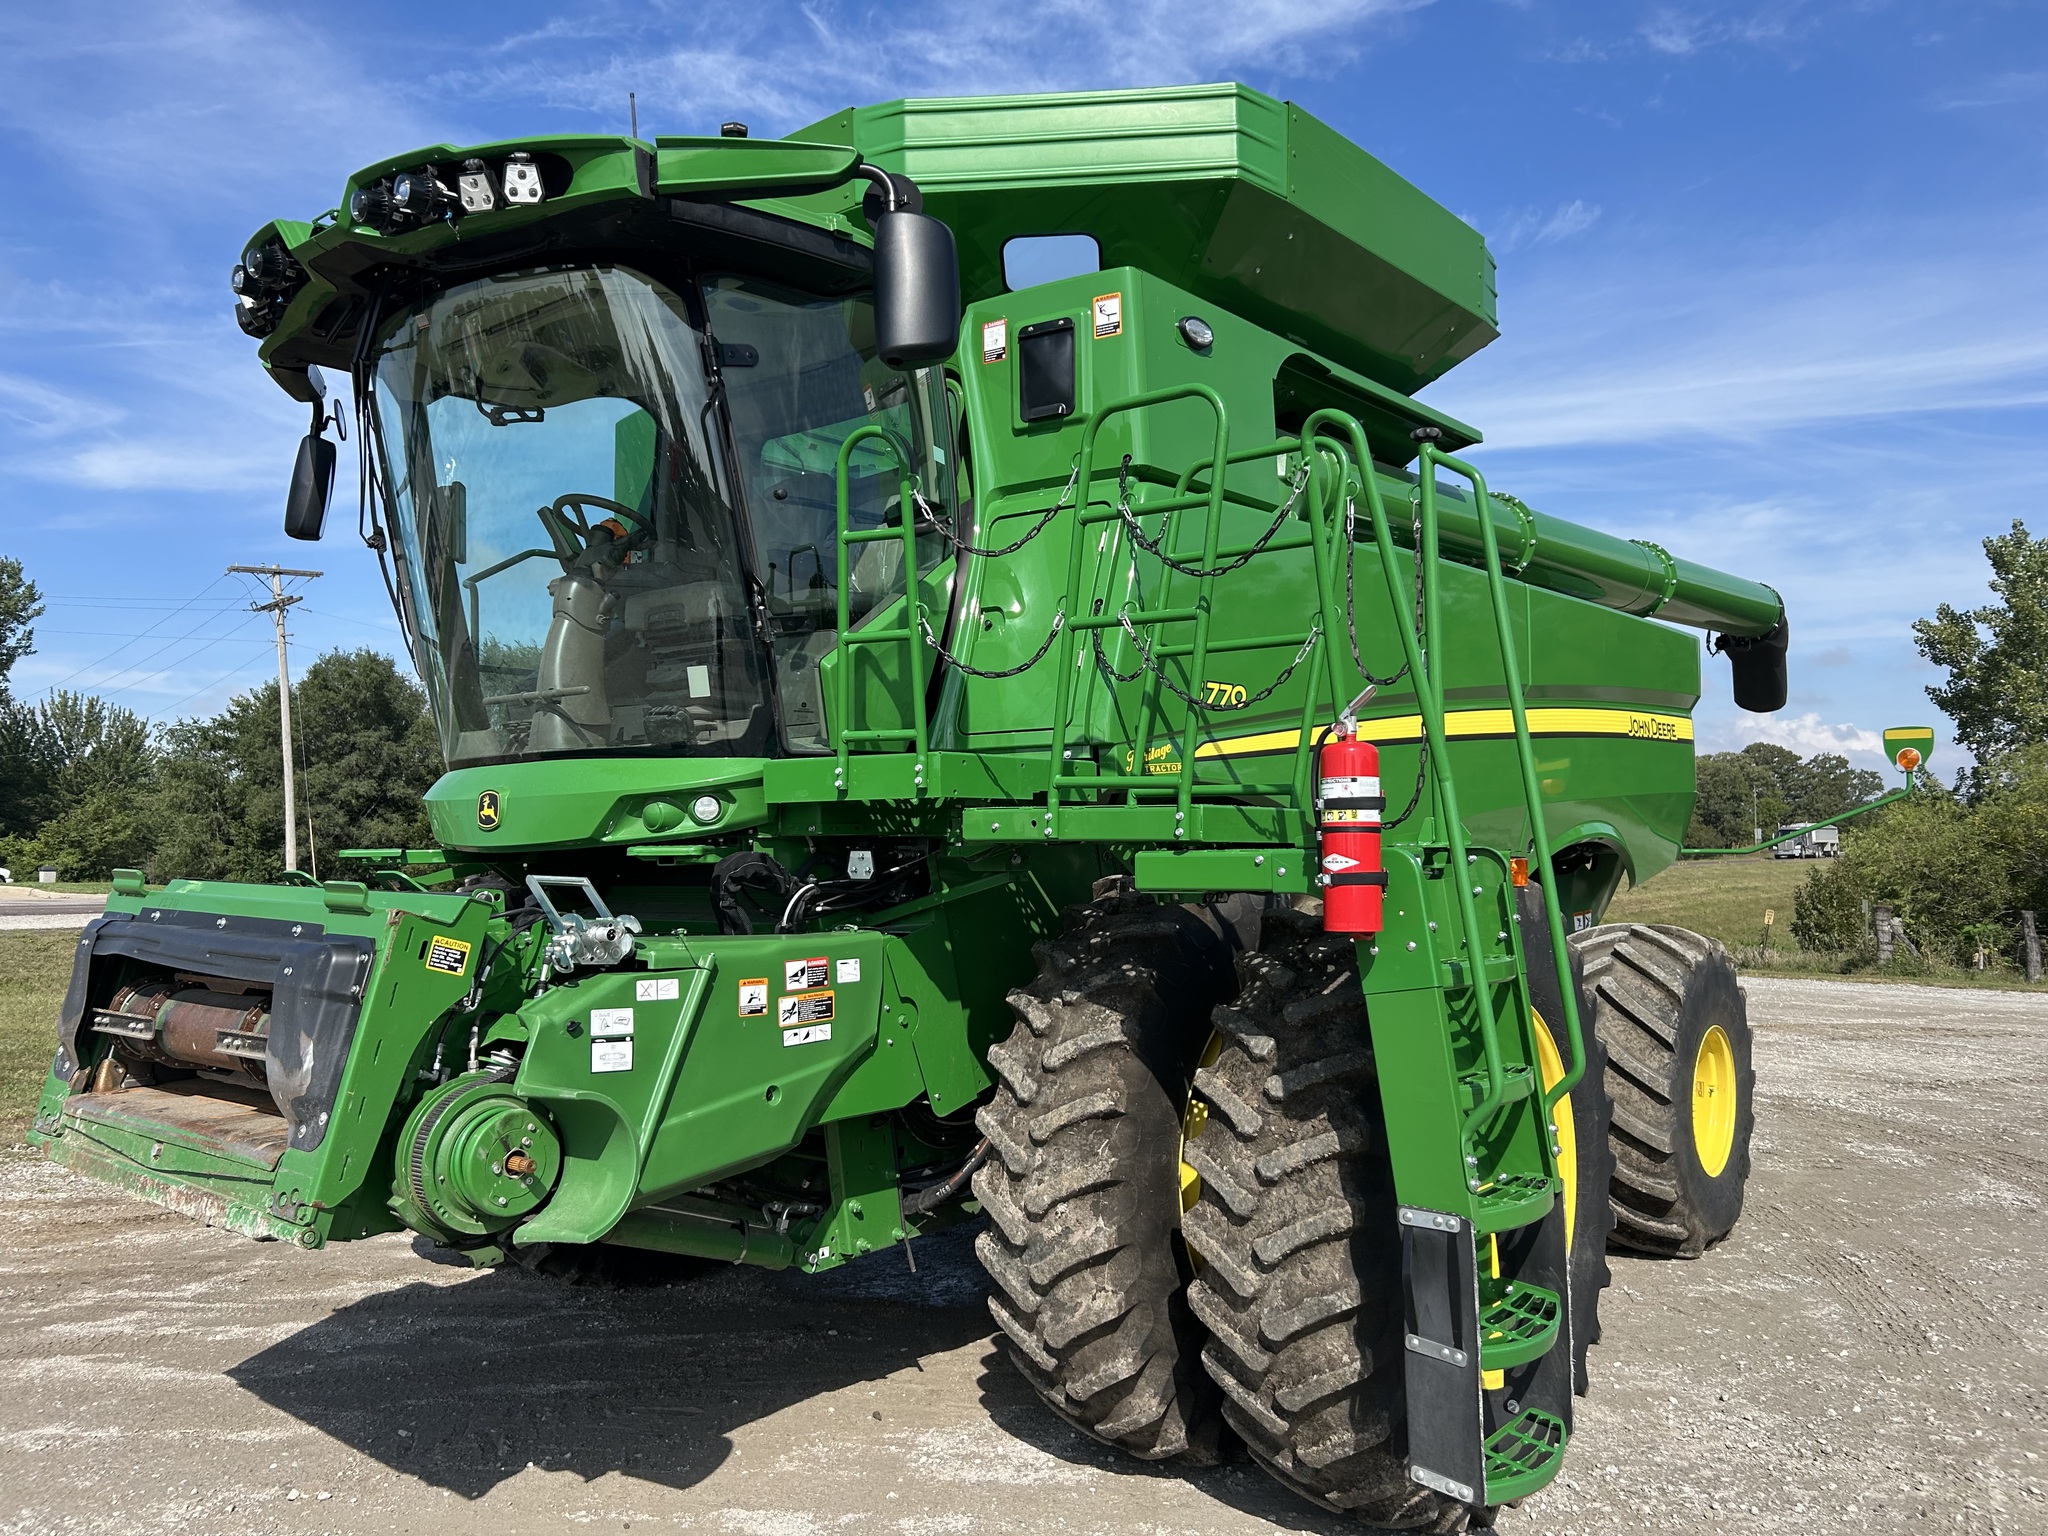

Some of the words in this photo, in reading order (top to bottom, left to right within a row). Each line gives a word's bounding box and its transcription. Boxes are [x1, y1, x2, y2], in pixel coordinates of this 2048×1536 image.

[988, 319, 1005, 328] DANGER
[1200, 681, 1247, 709] 770
[1628, 715, 1650, 736] JOHN
[1651, 718, 1677, 738] DEERE
[1126, 744, 1172, 772] ritage
[440, 938, 469, 950] CAUTION
